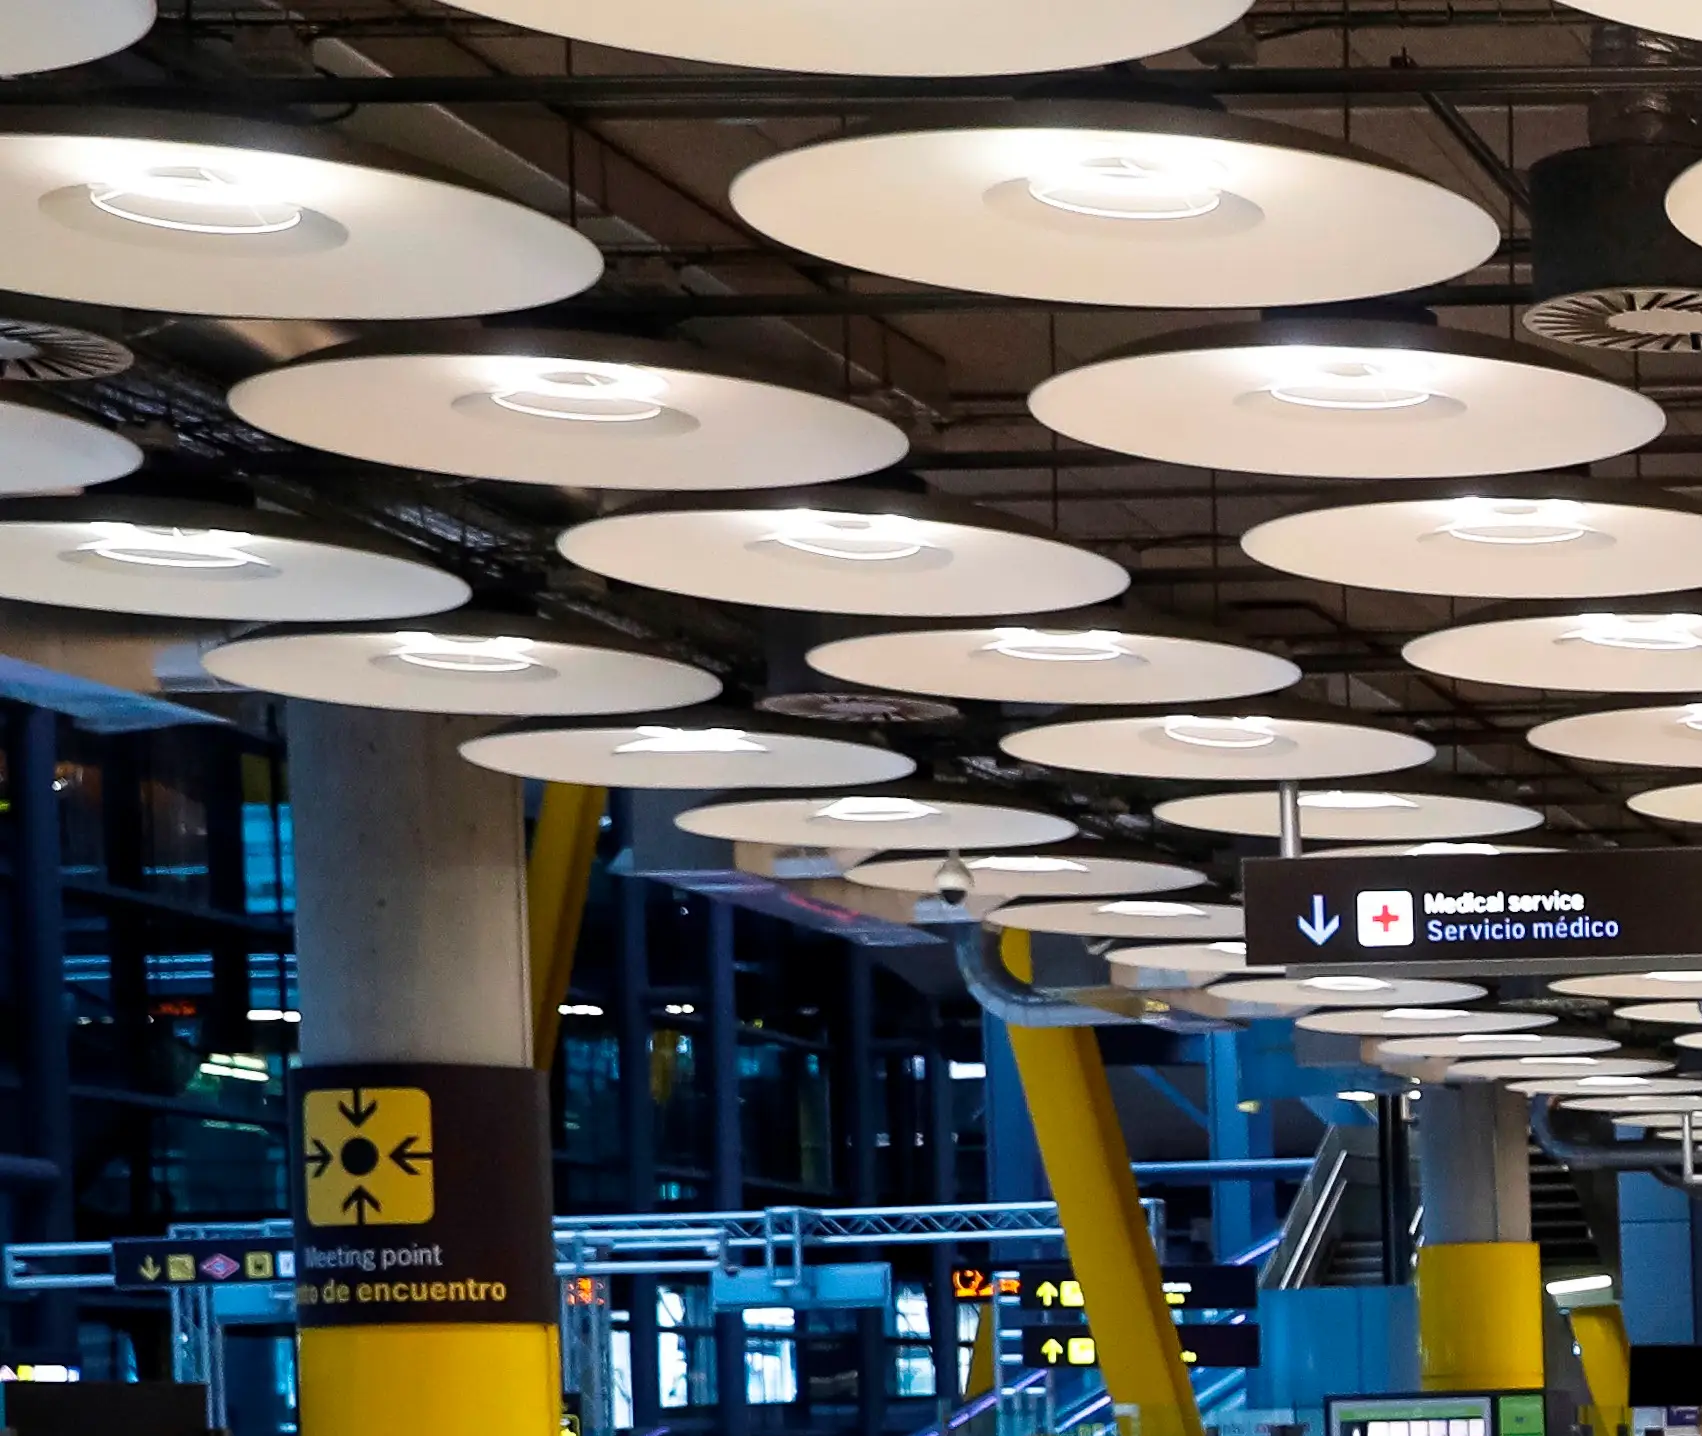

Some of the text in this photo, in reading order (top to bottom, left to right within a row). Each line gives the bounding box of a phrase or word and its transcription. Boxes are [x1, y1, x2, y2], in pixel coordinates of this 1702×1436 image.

[1424, 889, 1584, 914] Medical service
[1427, 915, 1619, 941] Servicio médico
[381, 1243, 443, 1270] point
[322, 1279, 350, 1303] de
[357, 1278, 507, 1302] encuentro
